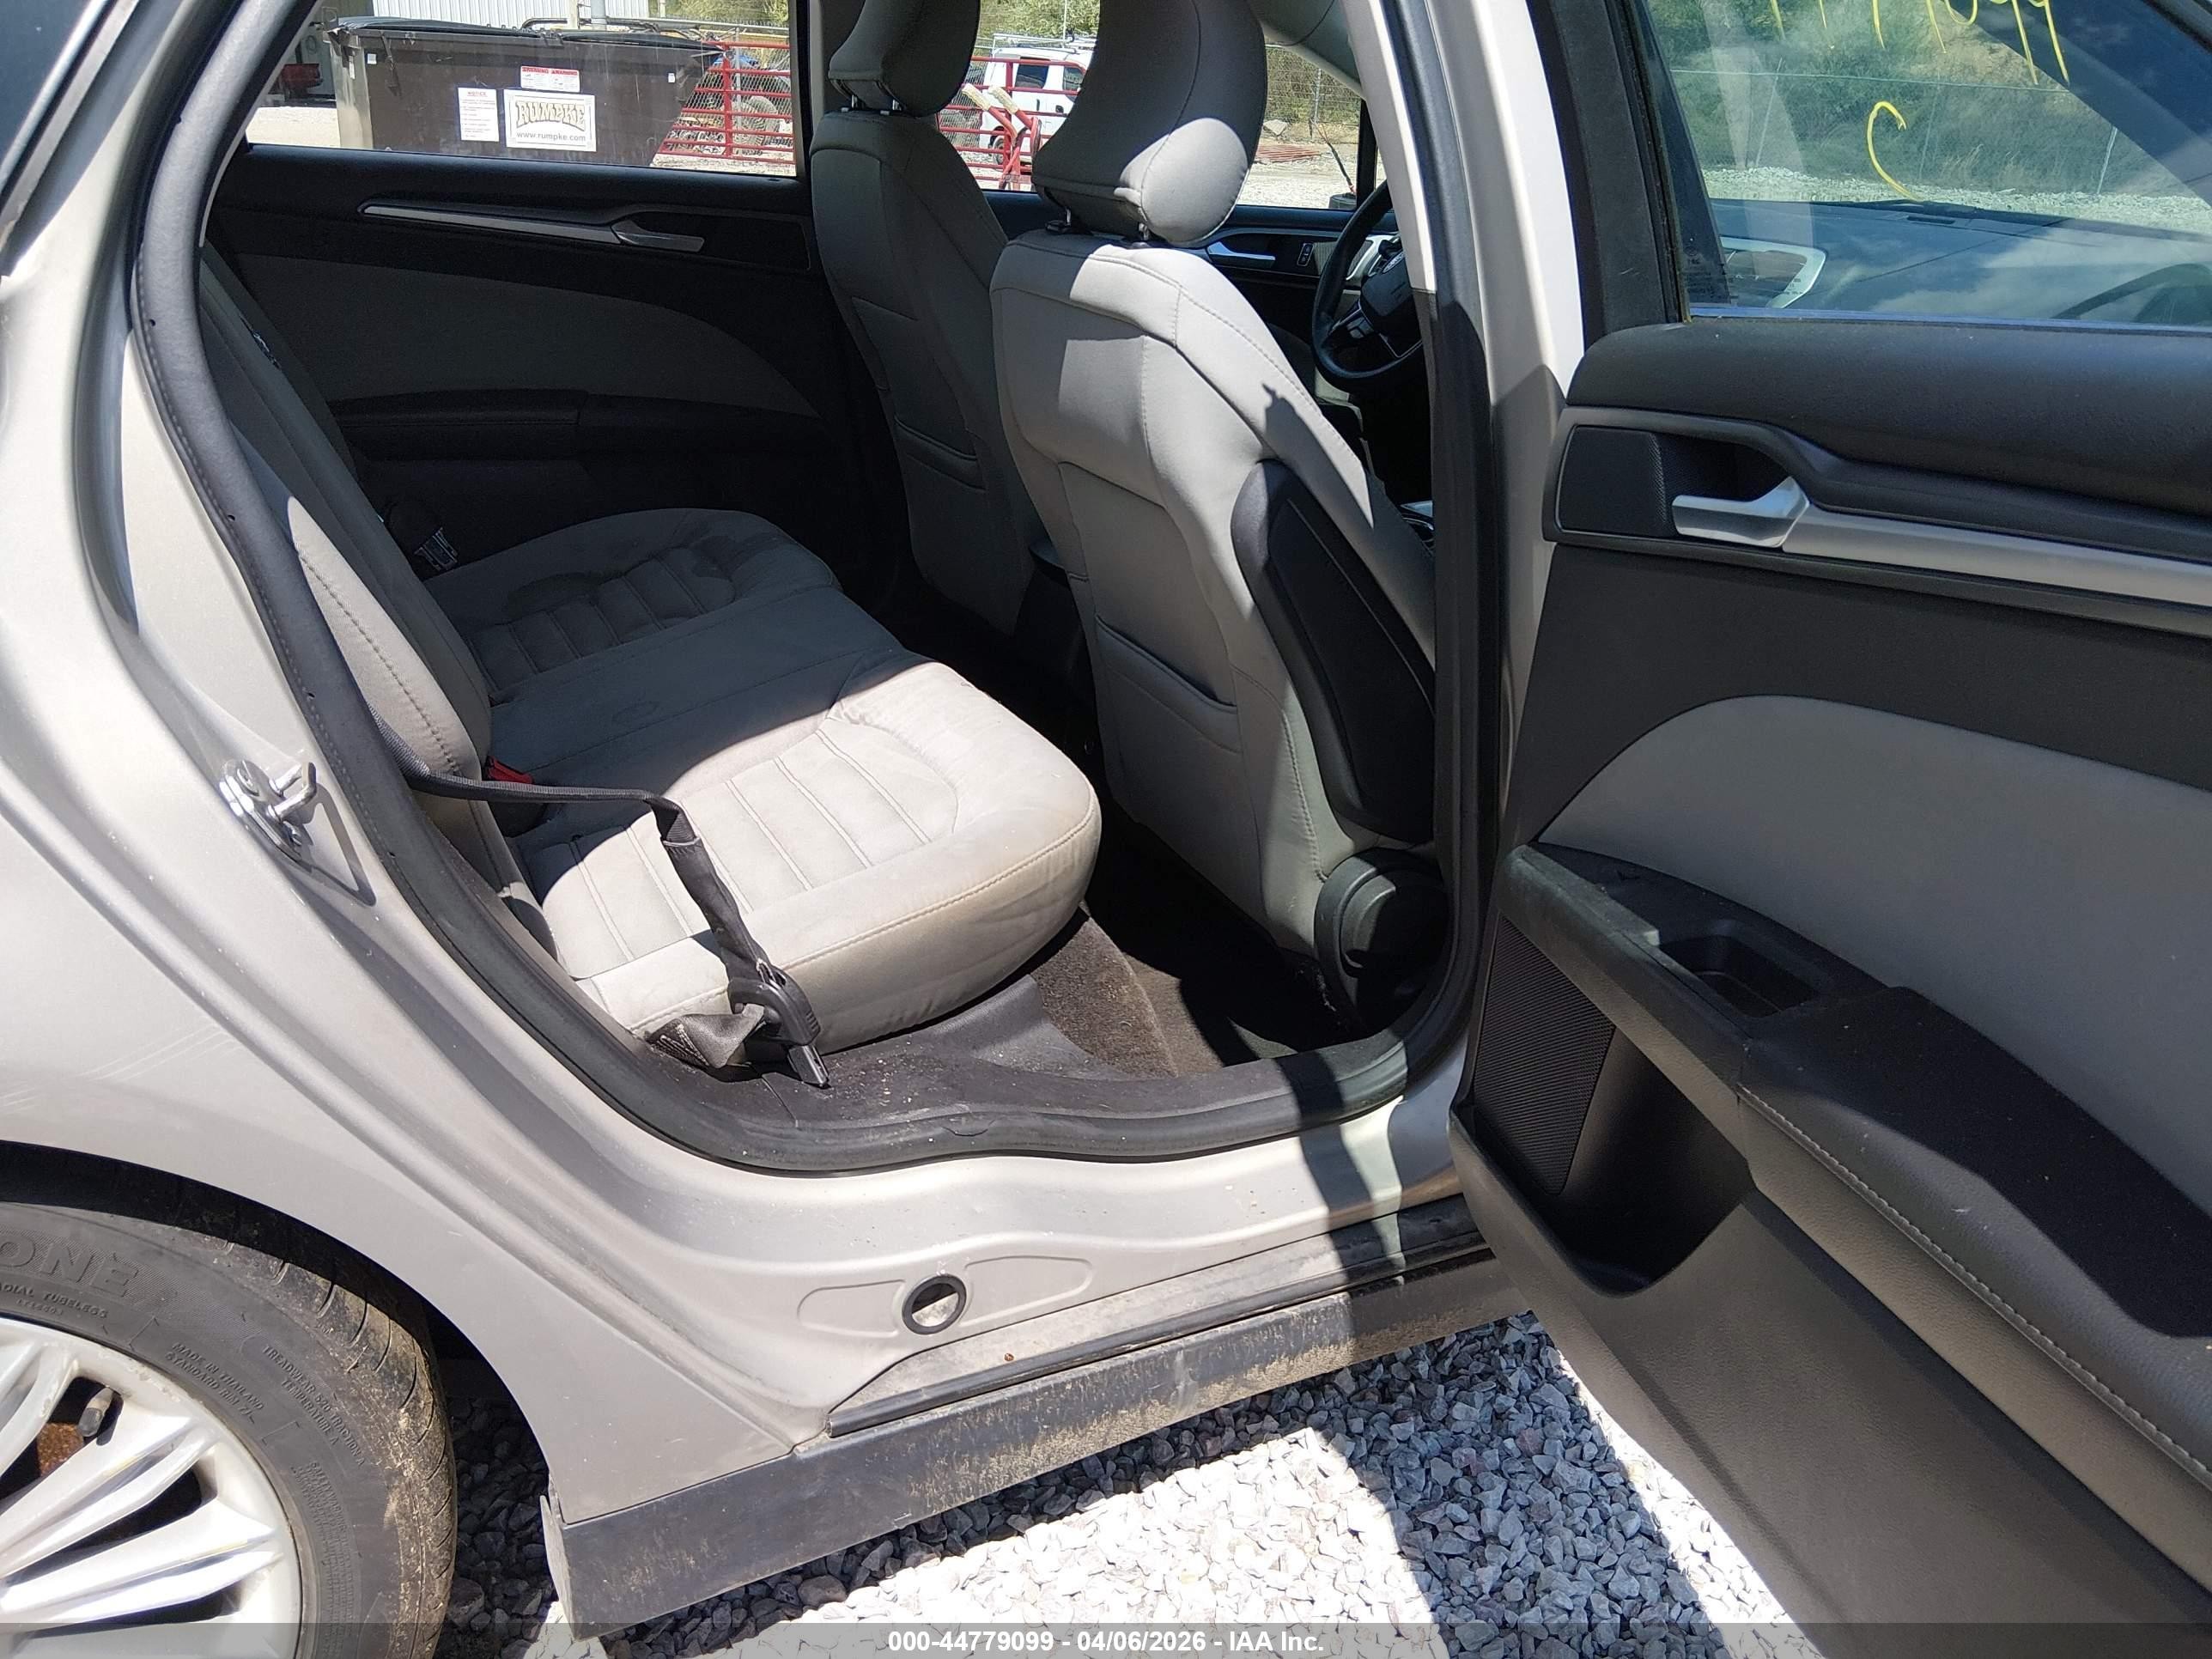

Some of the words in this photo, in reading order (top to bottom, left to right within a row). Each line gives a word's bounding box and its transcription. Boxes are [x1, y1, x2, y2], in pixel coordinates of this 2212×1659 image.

[516, 100, 586, 131] RUMPKE
[517, 131, 586, 142] www.rumpke.com
[165, 1352, 220, 1389] STANDARD
[205, 1362, 220, 1374] IN
[220, 1373, 264, 1409] THAILAND
[263, 1346, 316, 1395] TREADWEAR
[331, 1413, 362, 1457] TRACTION
[356, 1457, 366, 1467] A
[282, 1378, 331, 1437] TEMPERATURE
[330, 1437, 340, 1446] A
